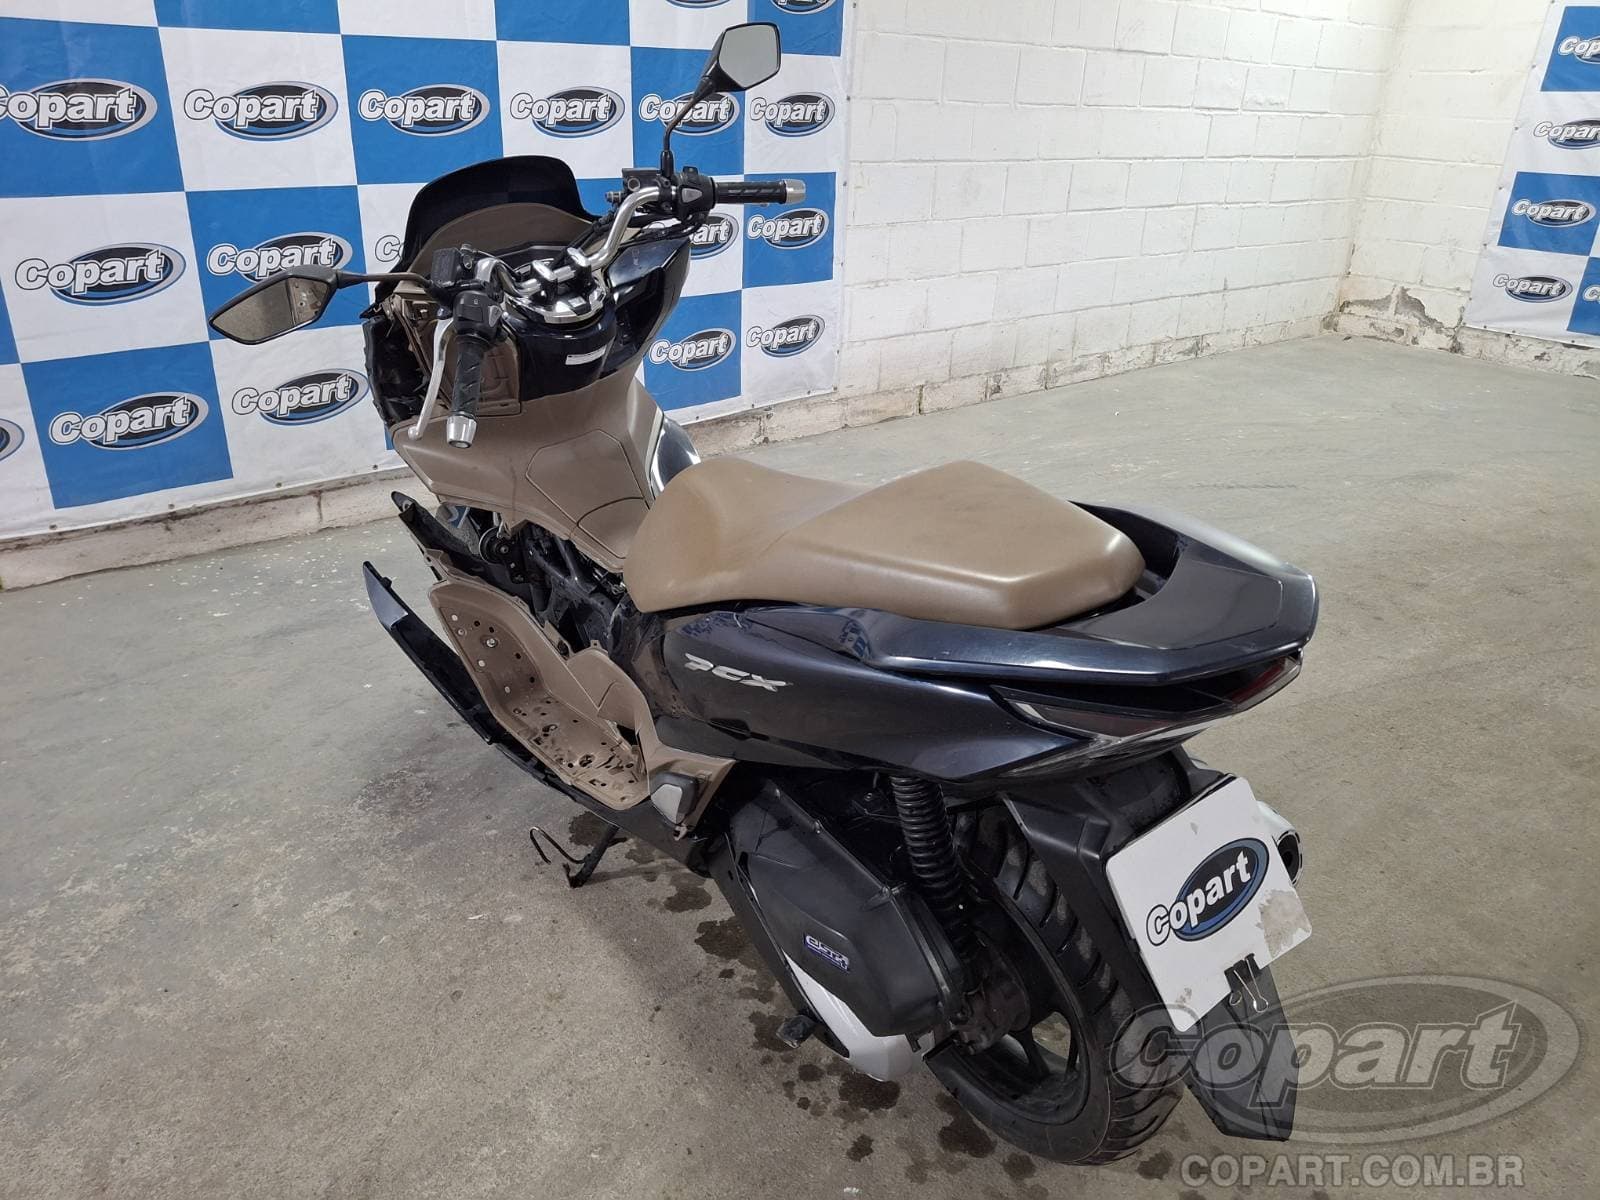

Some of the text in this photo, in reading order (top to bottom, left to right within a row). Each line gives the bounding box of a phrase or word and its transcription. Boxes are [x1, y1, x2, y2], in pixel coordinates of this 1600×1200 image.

[1559, 36, 1600, 58] Cop
[0, 84, 137, 130] opart
[184, 89, 318, 129] Copart
[359, 89, 477, 127] Copart
[510, 92, 612, 126] Copart
[750, 96, 827, 127] Copart
[1533, 120, 1600, 142] Copar
[1511, 198, 1586, 222] Copart
[694, 219, 730, 244] art
[747, 213, 824, 242] Copart
[15, 250, 165, 294] Copart
[1493, 273, 1564, 296] Copart
[649, 332, 730, 366] Copart
[744, 320, 818, 350] Copart
[232, 373, 353, 417] Copart
[49, 396, 190, 446] Copart
[1146, 848, 1254, 946] Copart
